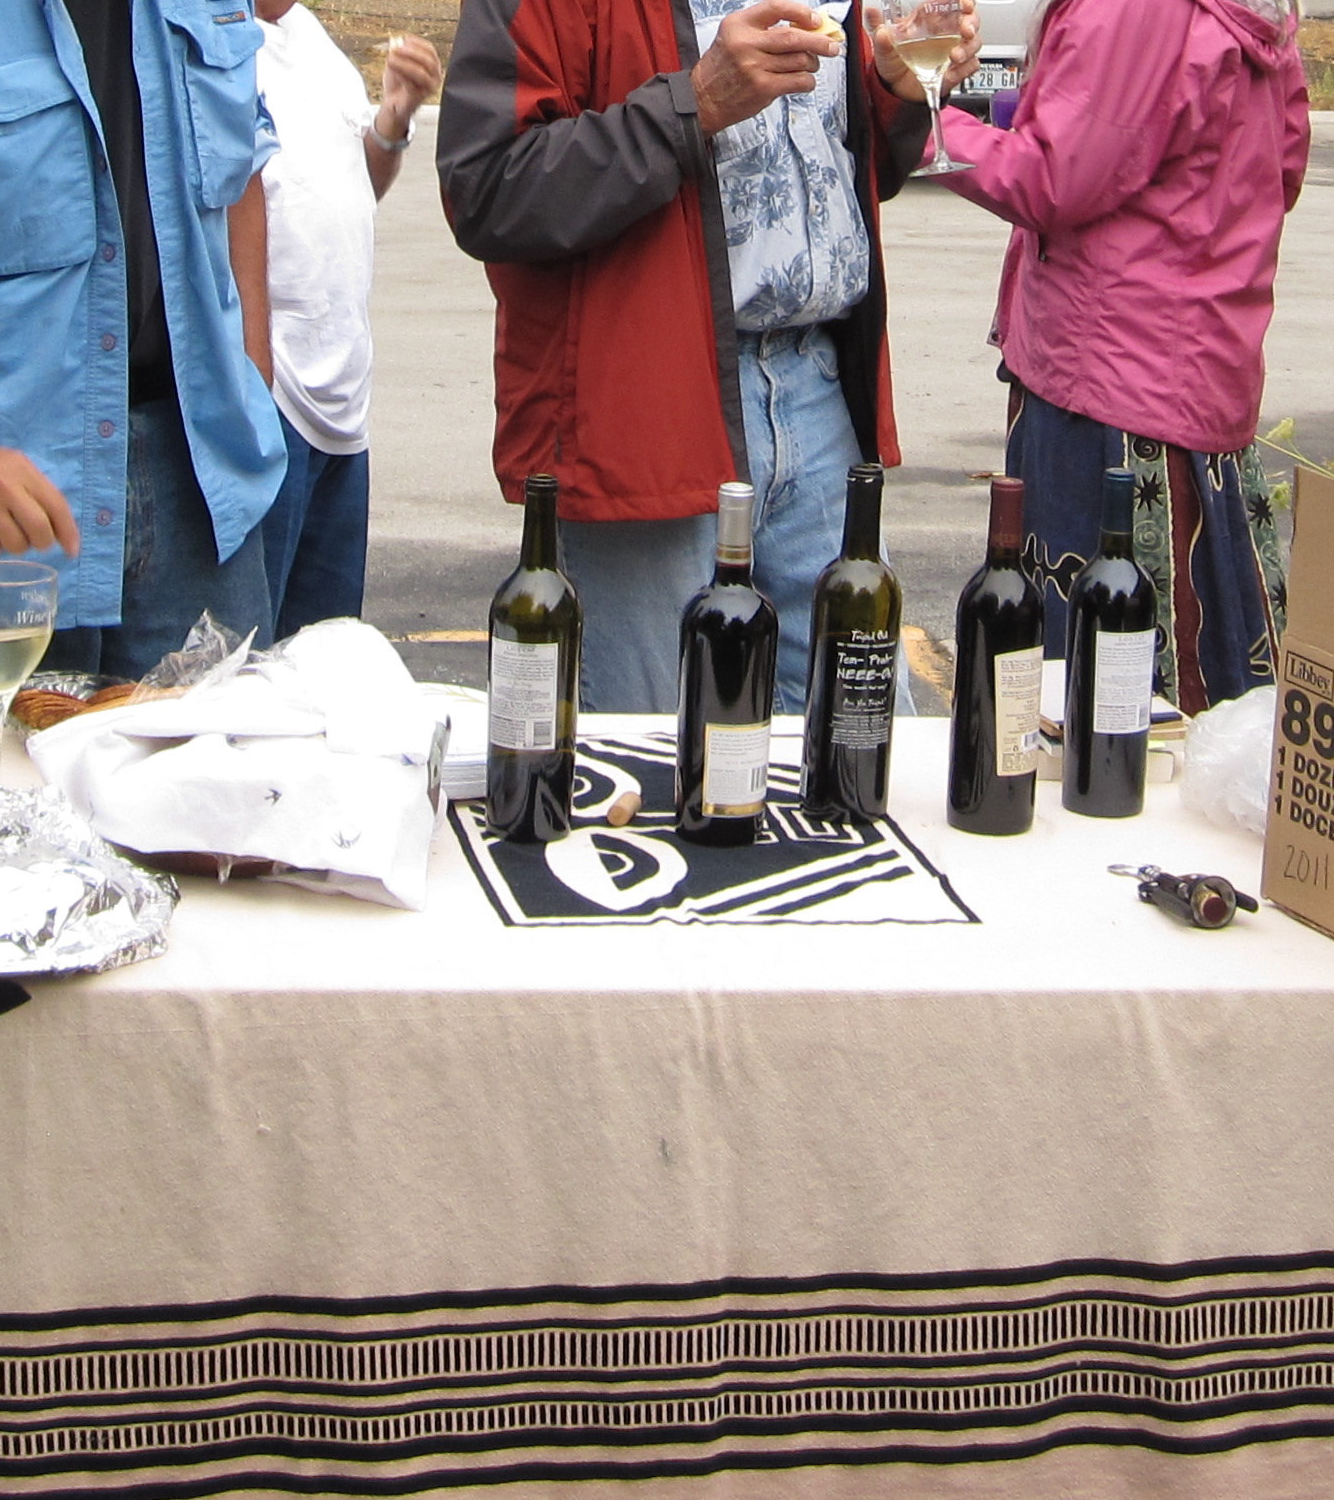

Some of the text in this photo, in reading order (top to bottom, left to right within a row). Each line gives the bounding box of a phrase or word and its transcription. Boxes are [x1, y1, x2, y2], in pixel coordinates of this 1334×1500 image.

[924, 1, 949, 14] Wine
[979, 72, 1016, 87] 28 GA
[1289, 656, 1331, 692] Libbey
[1278, 746, 1286, 766] 1
[1276, 770, 1284, 791] 1
[1274, 795, 1283, 815] 1
[1283, 844, 1329, 890] 2011
